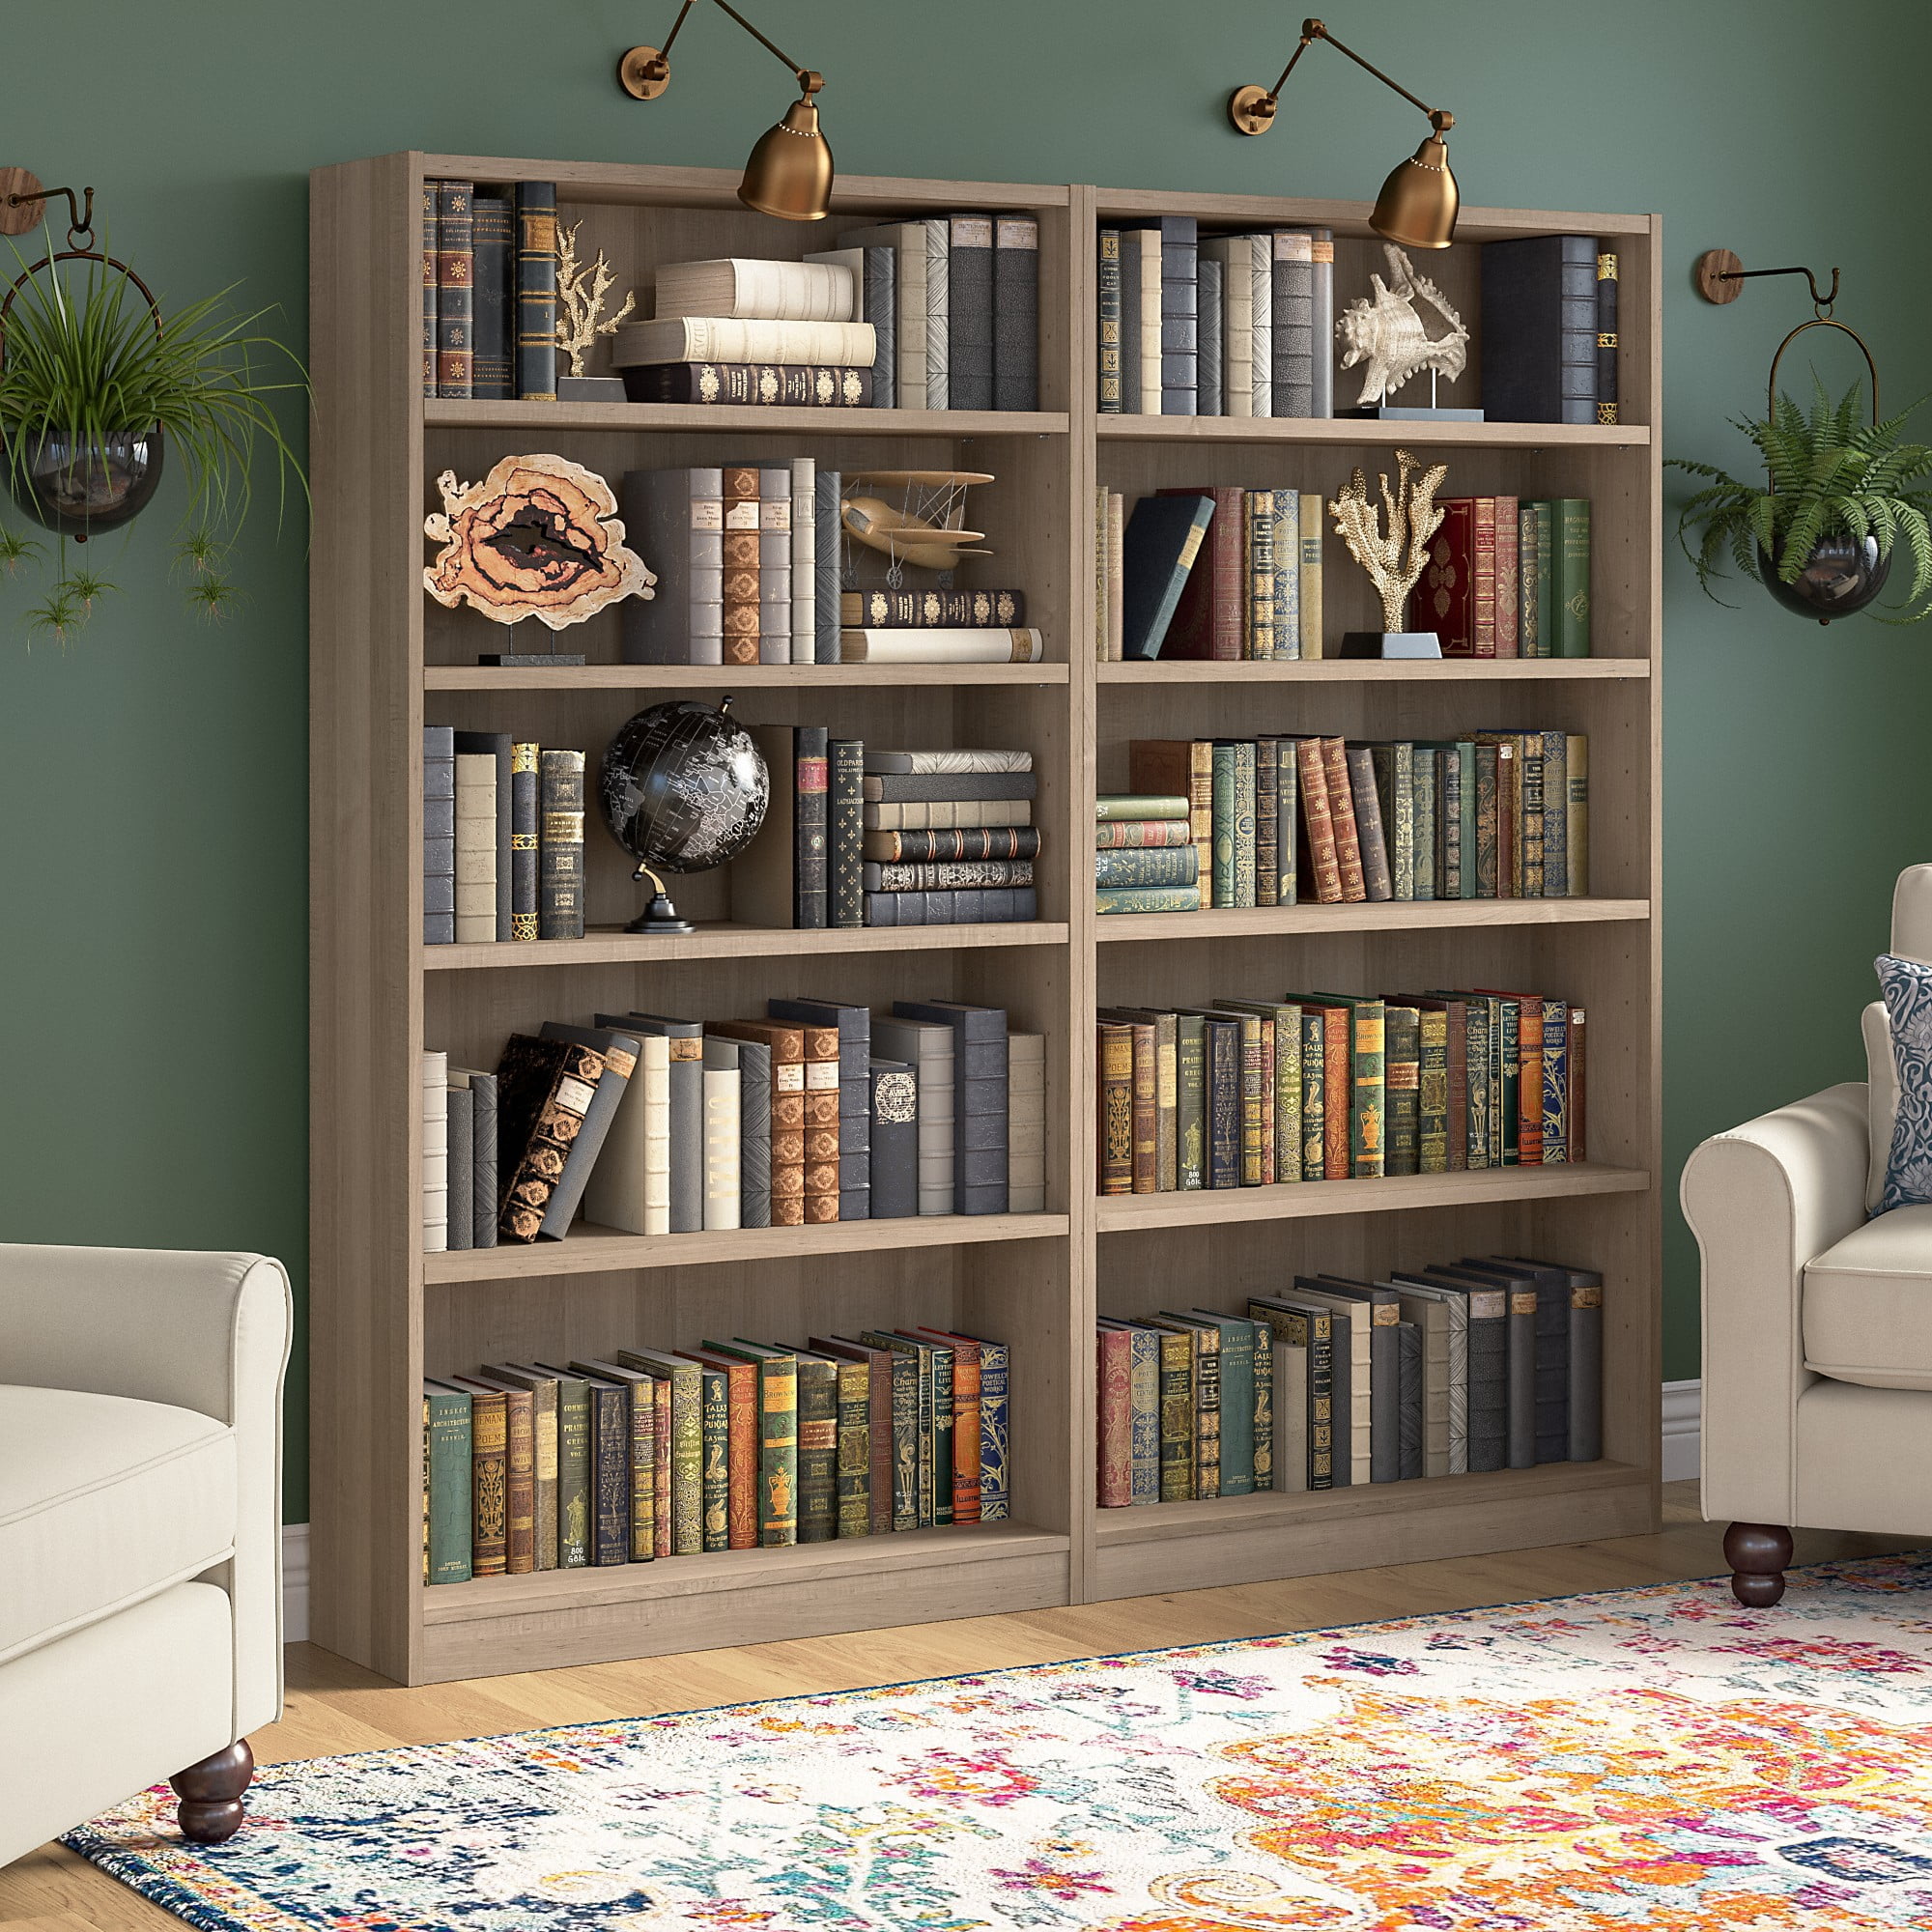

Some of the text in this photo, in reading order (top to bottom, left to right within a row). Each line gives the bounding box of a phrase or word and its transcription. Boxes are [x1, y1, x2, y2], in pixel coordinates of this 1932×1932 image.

[1228, 1334, 1251, 1343] INSECT
[980, 1372, 1008, 1380] LOWELL'S
[439, 1406, 469, 1416] INSECT
[703, 1403, 727, 1413] TALES
[474, 1434, 506, 1445] POEMS
